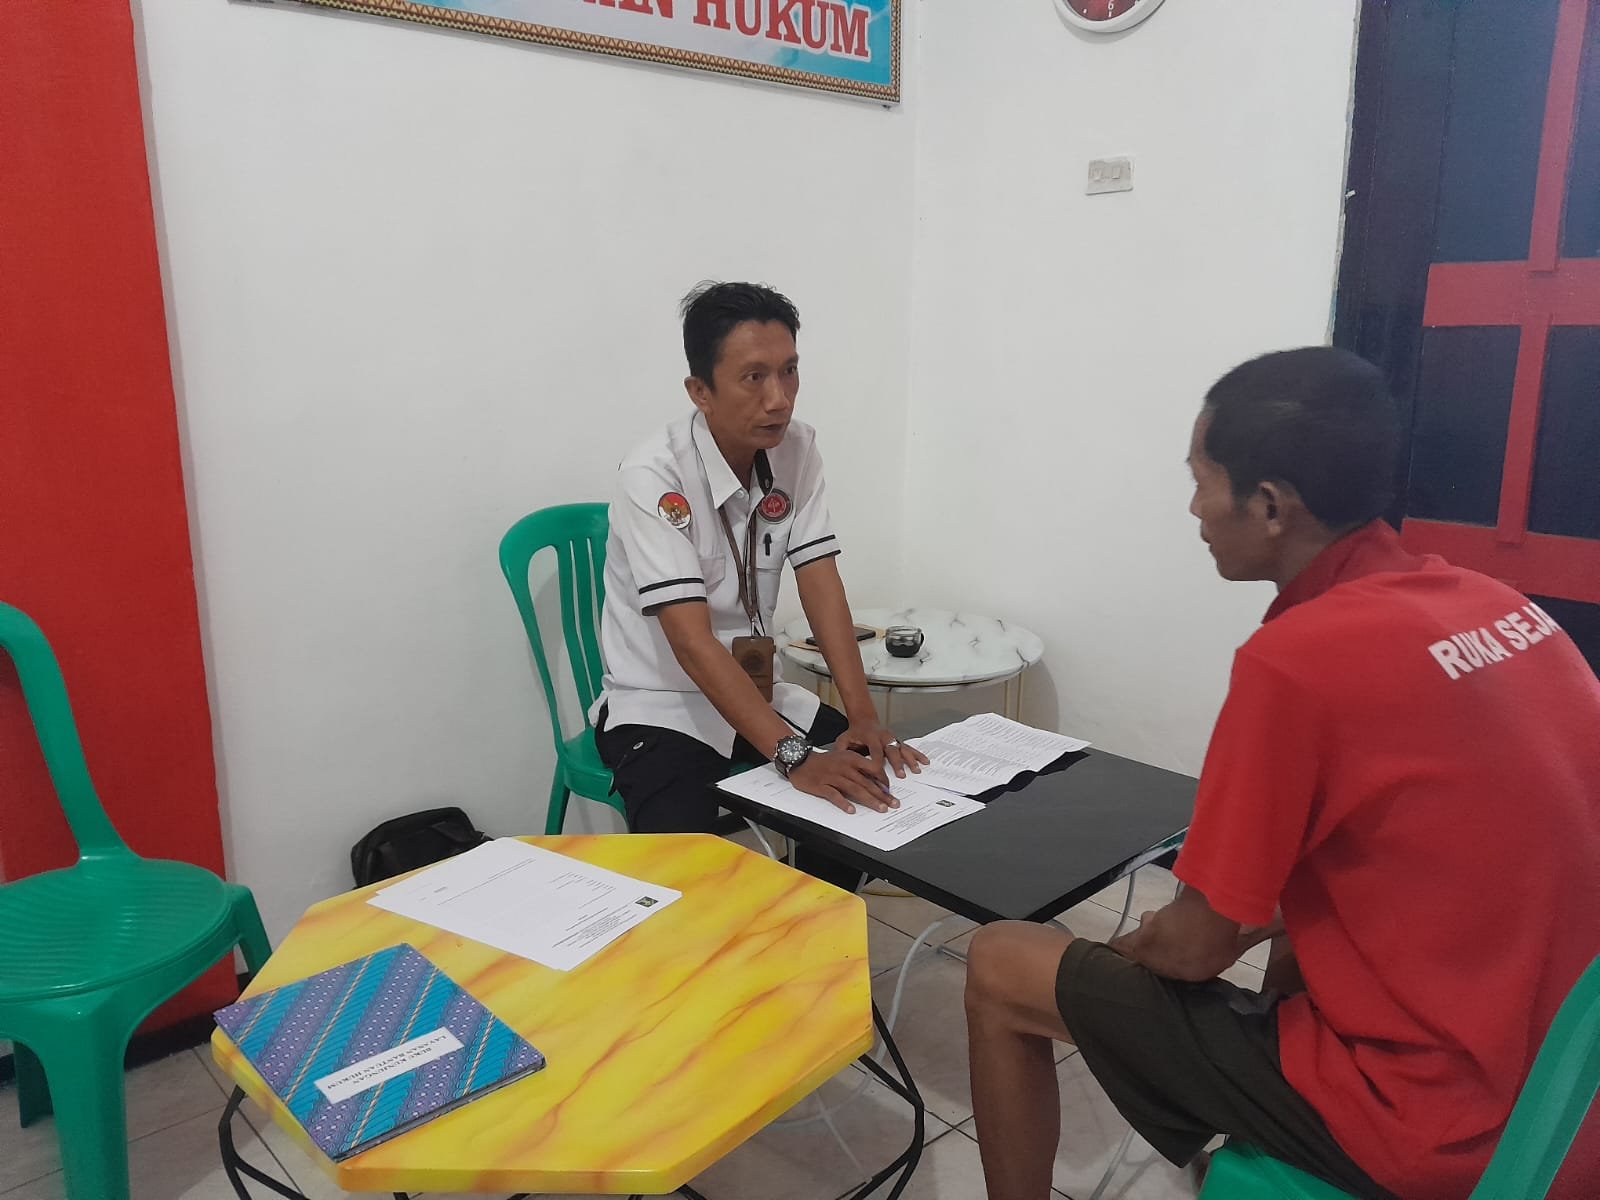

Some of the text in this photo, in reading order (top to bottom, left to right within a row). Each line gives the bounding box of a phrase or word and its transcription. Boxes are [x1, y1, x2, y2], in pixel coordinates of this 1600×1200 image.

[692, 0, 869, 58] HUKUM
[1427, 627, 1514, 680] RUKA
[327, 1070, 362, 1089] HUKUM
[352, 1046, 432, 1084] BUKU KUNJUNGAN
[363, 1052, 405, 1073] BANTUAN
